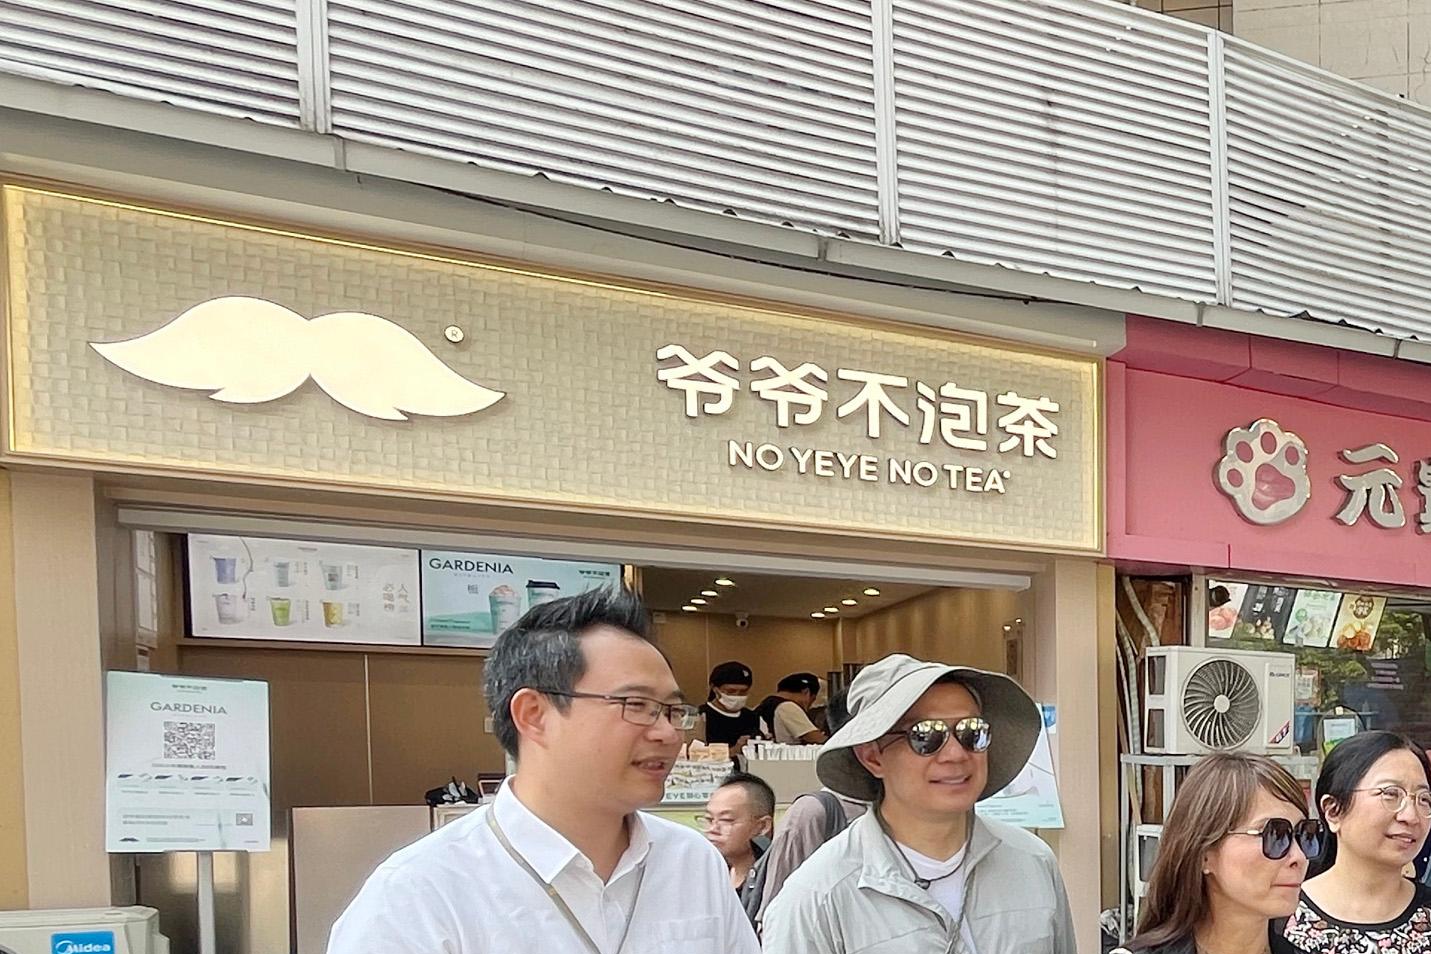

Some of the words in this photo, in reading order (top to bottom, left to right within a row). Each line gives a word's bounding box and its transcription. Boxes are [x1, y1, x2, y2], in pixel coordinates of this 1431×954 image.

[656, 343, 1060, 459] 爷爷不泡茶
[727, 439, 784, 472] NO
[790, 446, 879, 482] YEYE
[888, 458, 938, 488] NO
[943, 464, 1007, 494] TEA
[428, 557, 514, 575] GARDENIA
[149, 701, 229, 715] GARDENIA
